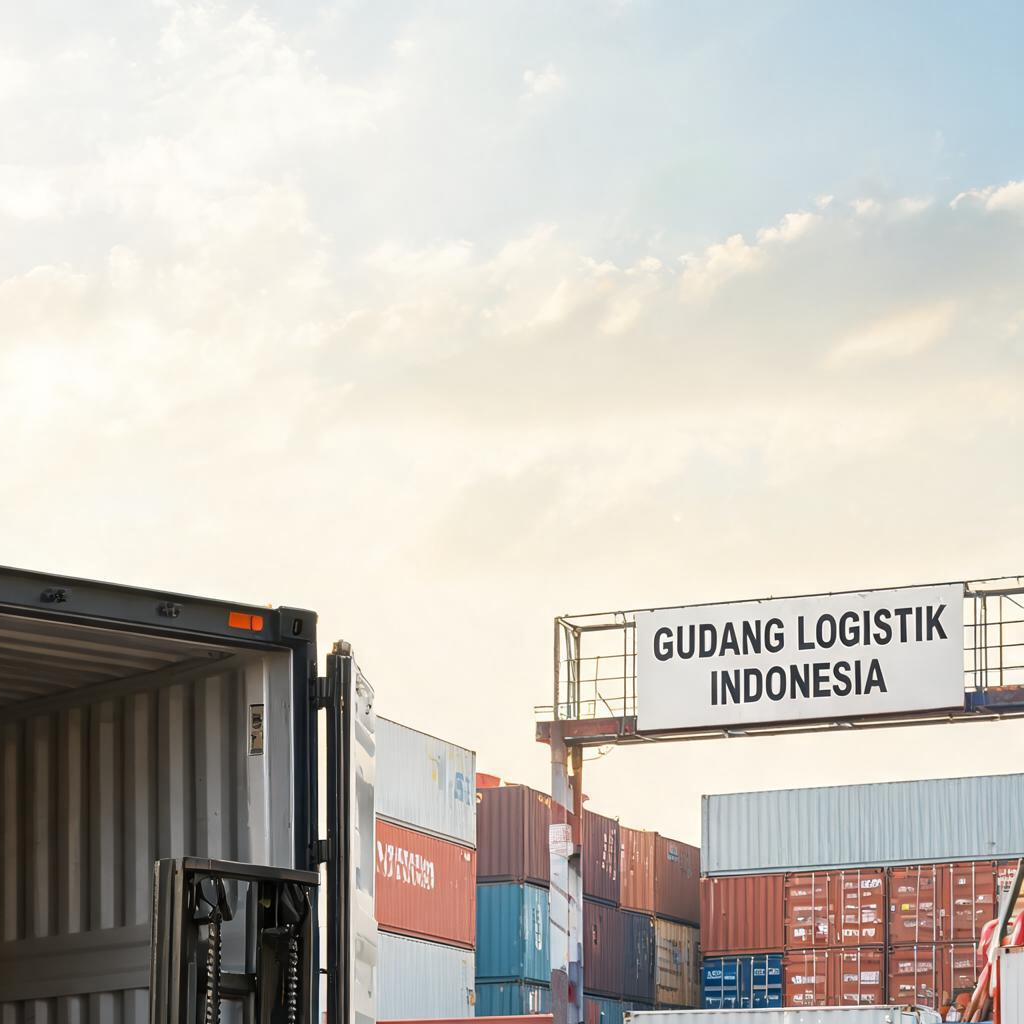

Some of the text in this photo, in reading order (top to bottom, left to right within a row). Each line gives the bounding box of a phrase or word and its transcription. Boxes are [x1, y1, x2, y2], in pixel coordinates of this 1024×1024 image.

[653, 603, 948, 661] GUDANG LOGISTIK
[711, 658, 888, 705] INDONESIA
